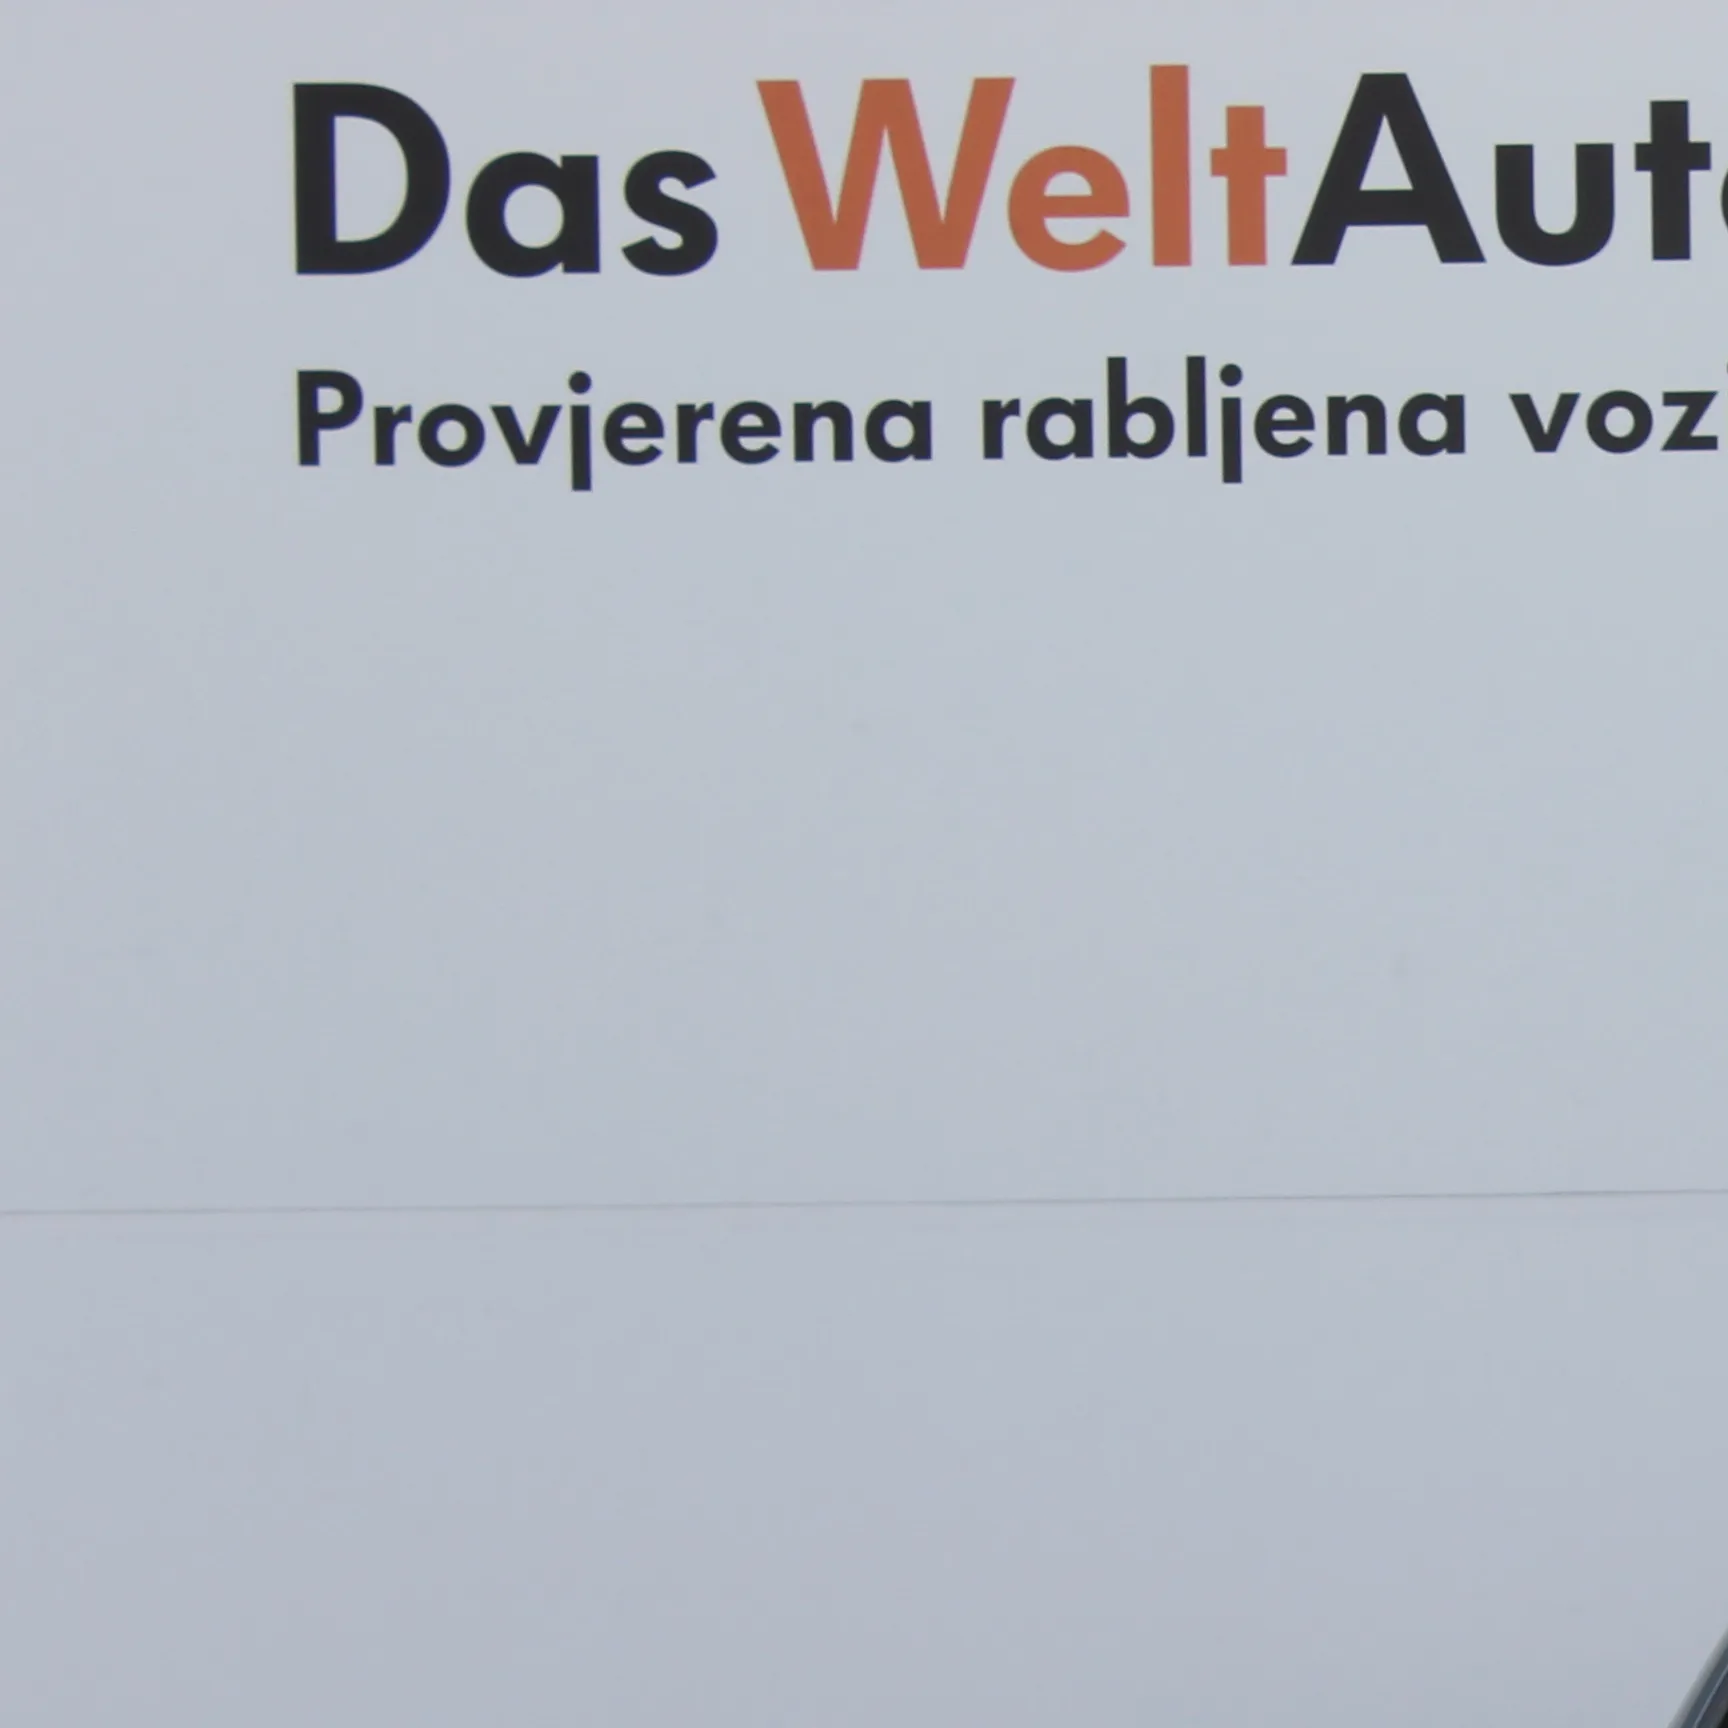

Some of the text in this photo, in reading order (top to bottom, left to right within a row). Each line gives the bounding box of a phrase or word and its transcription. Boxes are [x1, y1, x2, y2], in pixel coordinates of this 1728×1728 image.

[293, 82, 718, 278] Das
[296, 363, 932, 492] Provjerena
[982, 355, 1467, 484] rabljena
